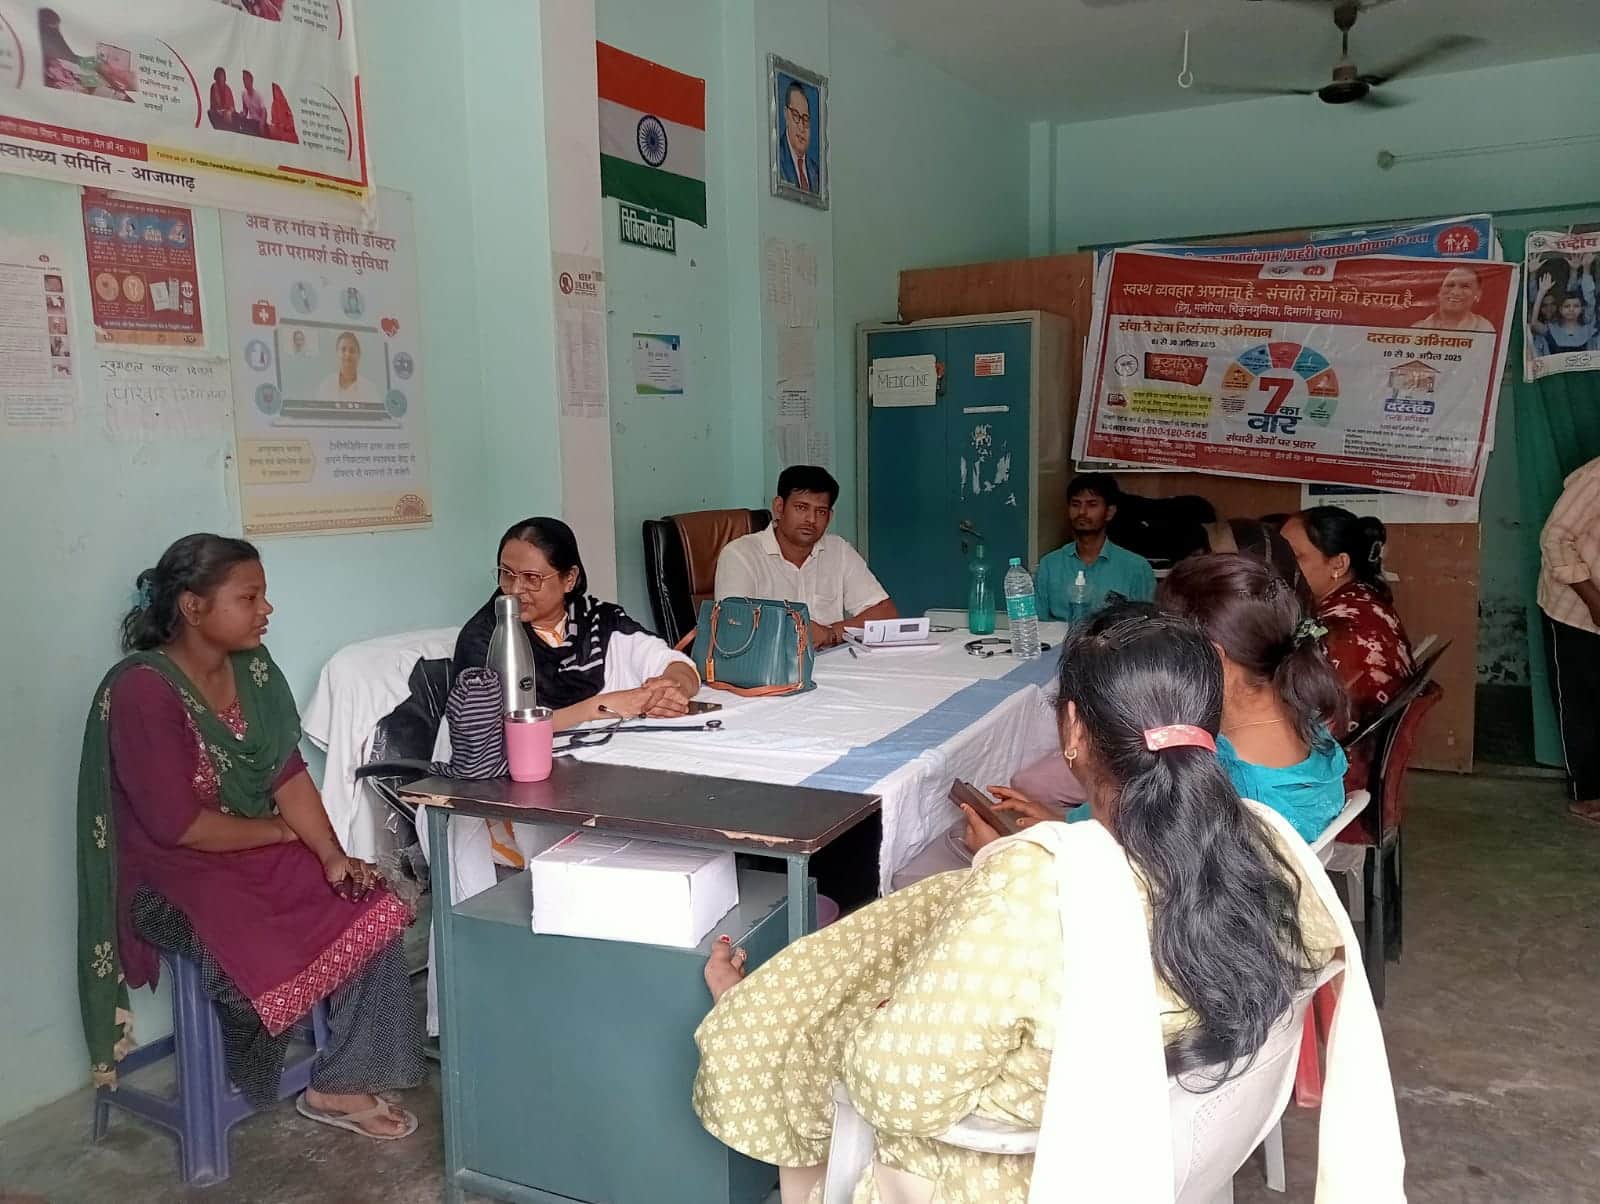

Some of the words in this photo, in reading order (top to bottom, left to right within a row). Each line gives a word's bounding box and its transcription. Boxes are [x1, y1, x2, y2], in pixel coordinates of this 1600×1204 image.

[61, 152, 112, 176] समिति
[132, 165, 197, 193] आजमगढ़
[246, 213, 269, 231] अब
[273, 218, 289, 237] हर
[291, 218, 317, 238] गांव
[319, 220, 331, 241] में
[334, 224, 360, 246] होगी
[361, 229, 397, 252] डॉक्टर
[255, 239, 283, 259] द्वारा
[286, 243, 328, 265] परामर्श
[330, 246, 348, 267] की
[350, 251, 390, 274] सुविधा
[1123, 283, 1151, 298] स्वस्थ
[1155, 283, 1195, 299] व्यवहार
[1197, 285, 1242, 300] अपनाना
[1245, 281, 1256, 300] है
[1266, 283, 1305, 301] संचारी
[1308, 285, 1338, 303] रोगों
[1340, 287, 1359, 304] को
[1363, 292, 1400, 307] हराना
[1119, 319, 1150, 332] संचारी
[1153, 320, 1173, 334] रोग
[1220, 323, 1273, 338] अभियान
[1367, 332, 1411, 345] दस्तक
[1413, 334, 1473, 349] अभियान
[877, 373, 929, 389] MEDICINE
[1258, 376, 1294, 415] 7
[1279, 406, 1300, 416] का
[1248, 412, 1302, 435] वार
[1226, 432, 1253, 443] संचारी
[1278, 438, 1291, 446] पर
